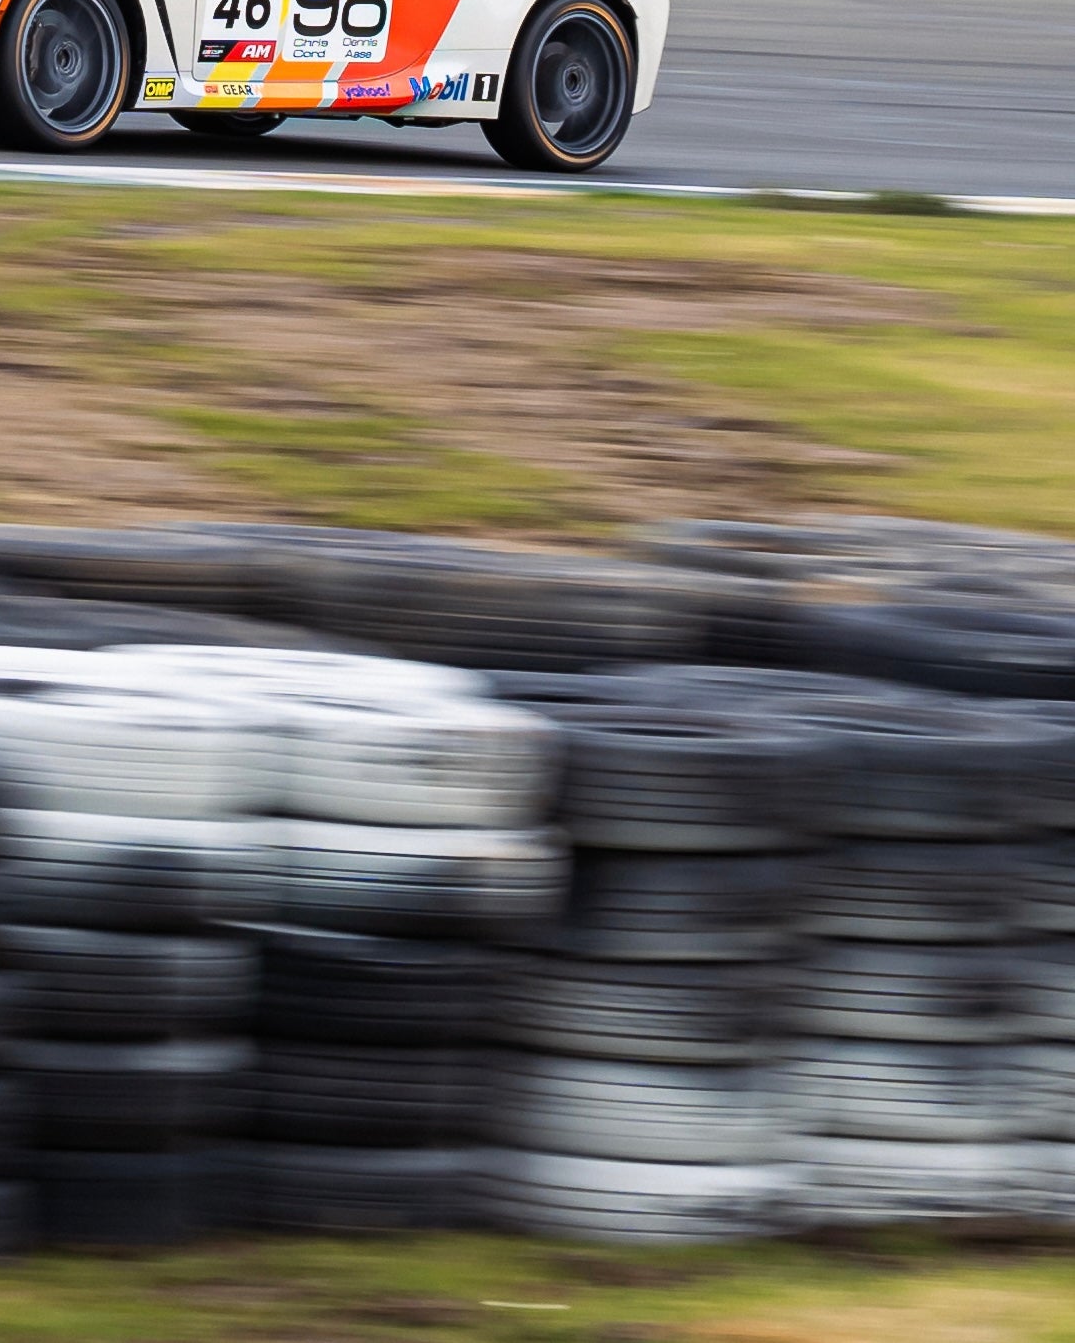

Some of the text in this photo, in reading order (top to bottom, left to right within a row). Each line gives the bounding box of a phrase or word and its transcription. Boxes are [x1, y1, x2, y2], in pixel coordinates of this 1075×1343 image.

[293, 38, 329, 47] Chris
[342, 37, 378, 47] Dennis
[241, 44, 272, 59] AM
[292, 49, 326, 58] Cord
[345, 49, 372, 58] Aase
[145, 83, 174, 96] OMP
[222, 84, 254, 96] GEAR
[341, 82, 391, 102] yahoo!
[409, 72, 470, 104] Mobil
